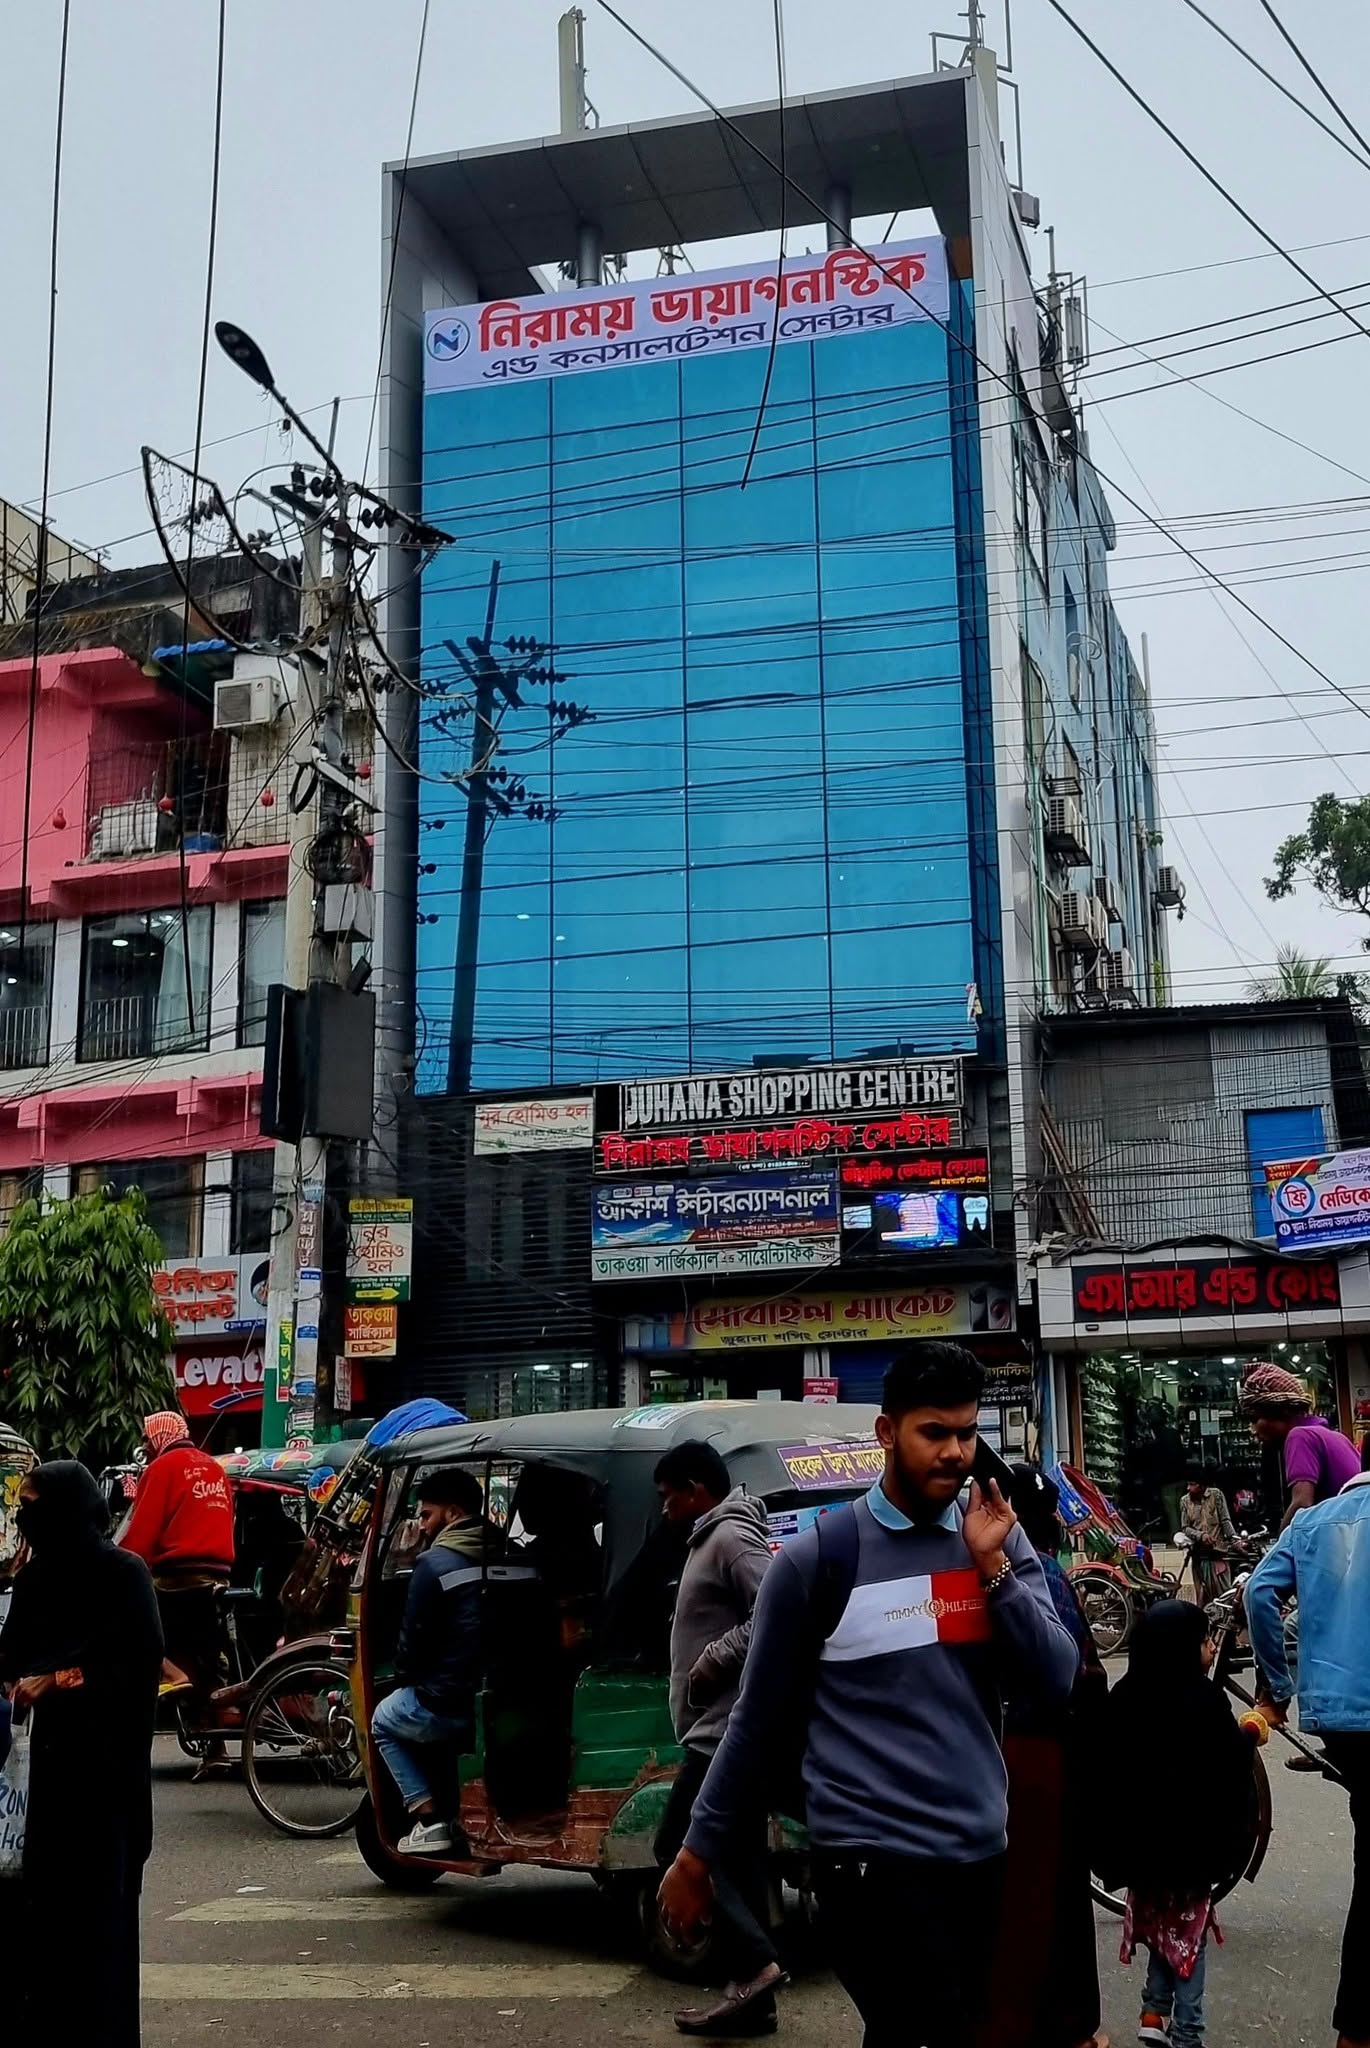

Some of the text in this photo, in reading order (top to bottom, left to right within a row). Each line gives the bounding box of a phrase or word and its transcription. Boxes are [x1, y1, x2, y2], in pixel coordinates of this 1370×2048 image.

[478, 248, 926, 352] নিরাময় ডায়াগনস্টিক
[779, 303, 895, 338] সেন্টার
[626, 1069, 956, 1126] JUHANA SHOPPING CENTRE
[602, 1111, 952, 1169] নিরাময় ডায়াগনস্টিক সেন্টার
[595, 1256, 649, 1275] তাকওয়া
[654, 1249, 719, 1273] সার্জিক্যাল
[347, 1307, 393, 1324] তাকওয়া
[692, 1296, 833, 1335] মোবাইল
[817, 1327, 869, 1340] সেন্টার
[884, 1604, 924, 1622] TOMMY
